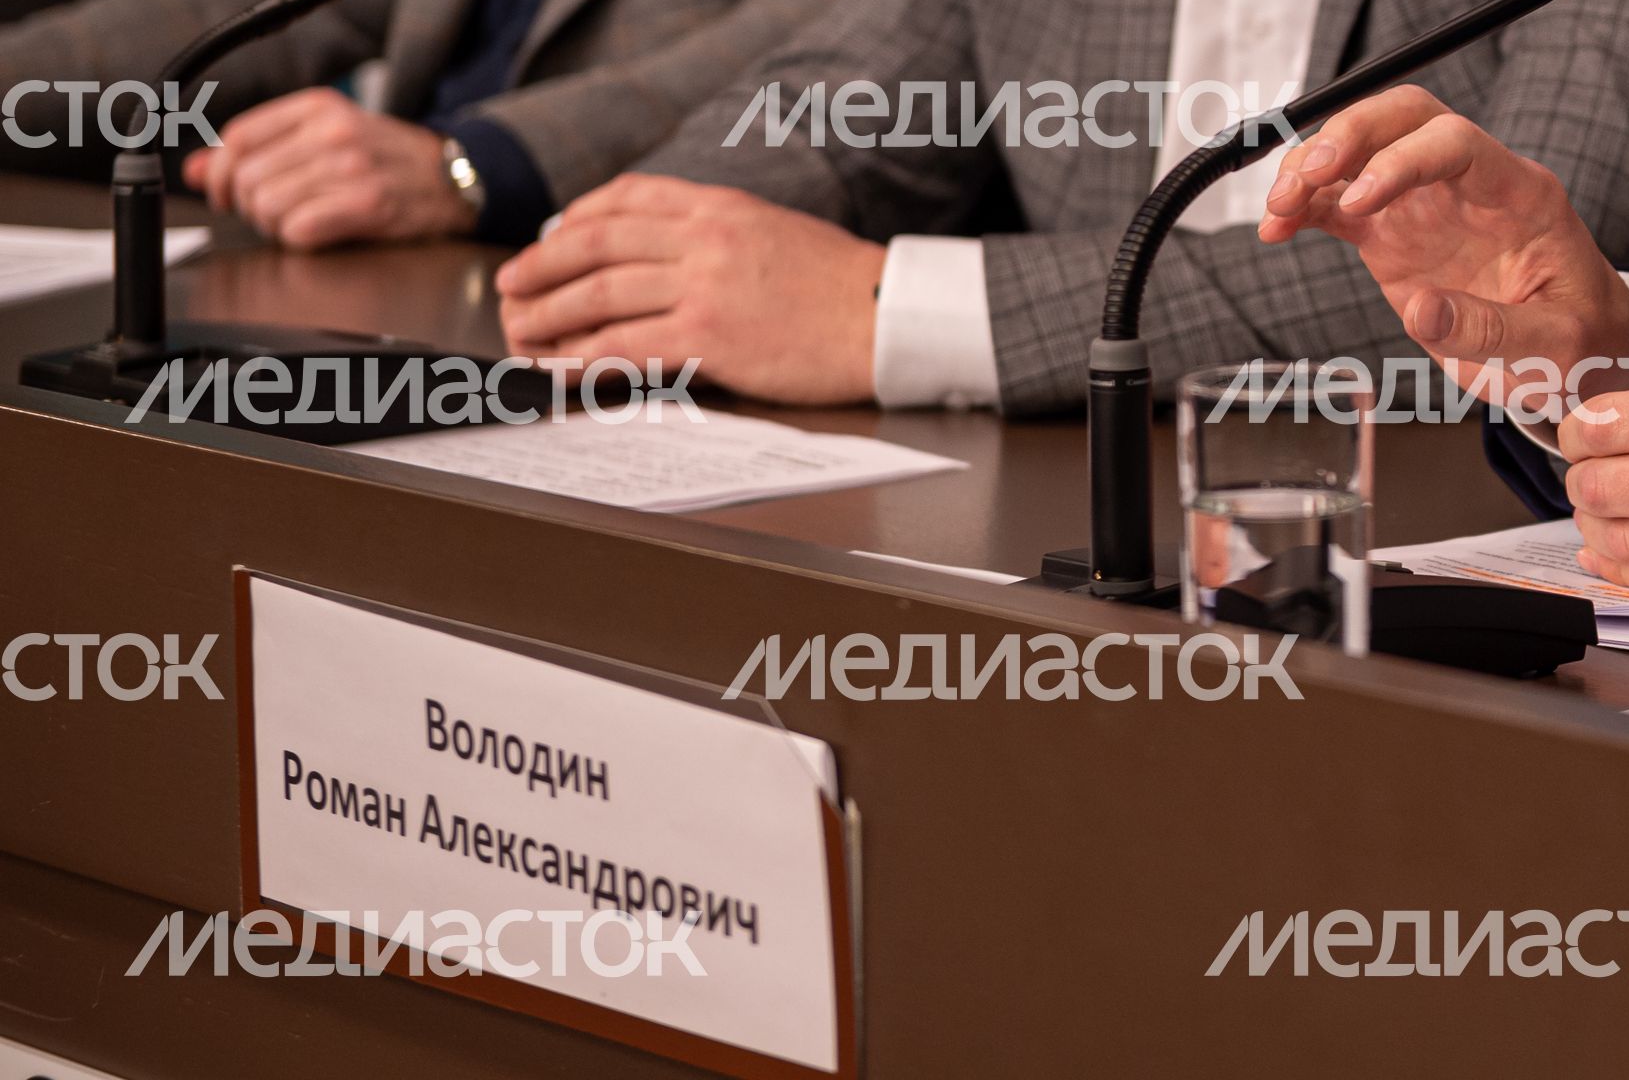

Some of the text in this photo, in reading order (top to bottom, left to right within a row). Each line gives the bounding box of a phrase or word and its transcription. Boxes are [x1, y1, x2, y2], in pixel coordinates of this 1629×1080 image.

[425, 698, 611, 801] Володин
[282, 749, 760, 946] Роман Александрович
